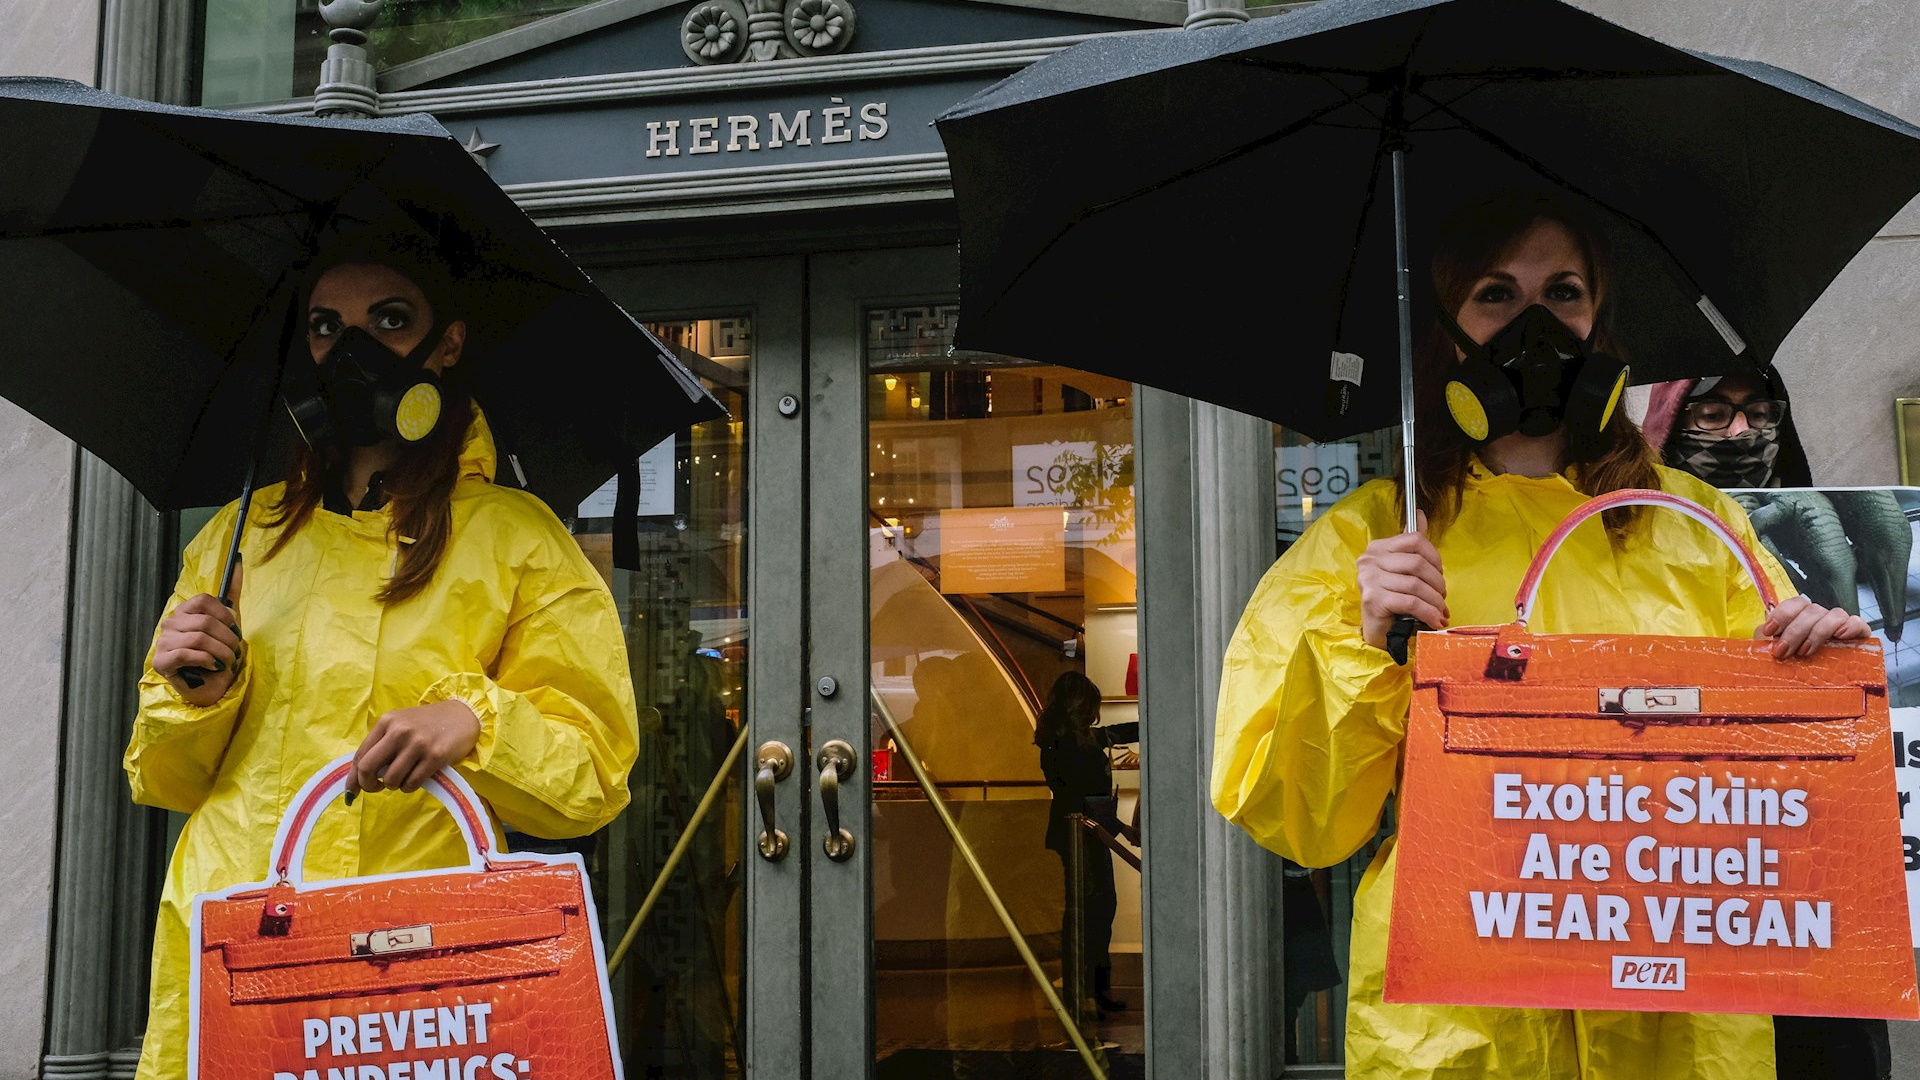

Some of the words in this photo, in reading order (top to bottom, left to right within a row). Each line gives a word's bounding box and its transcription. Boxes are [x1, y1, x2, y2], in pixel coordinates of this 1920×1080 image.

[645, 96, 889, 158] HERMÈS
[1493, 773, 1652, 824] Exotic
[1664, 775, 1809, 827] Skins
[1519, 833, 1611, 882] Are
[1624, 835, 1779, 886] Cruel:
[1469, 891, 1631, 942] WEAR
[1643, 896, 1832, 948] VEGAN
[303, 1002, 492, 1059] PREVENT
